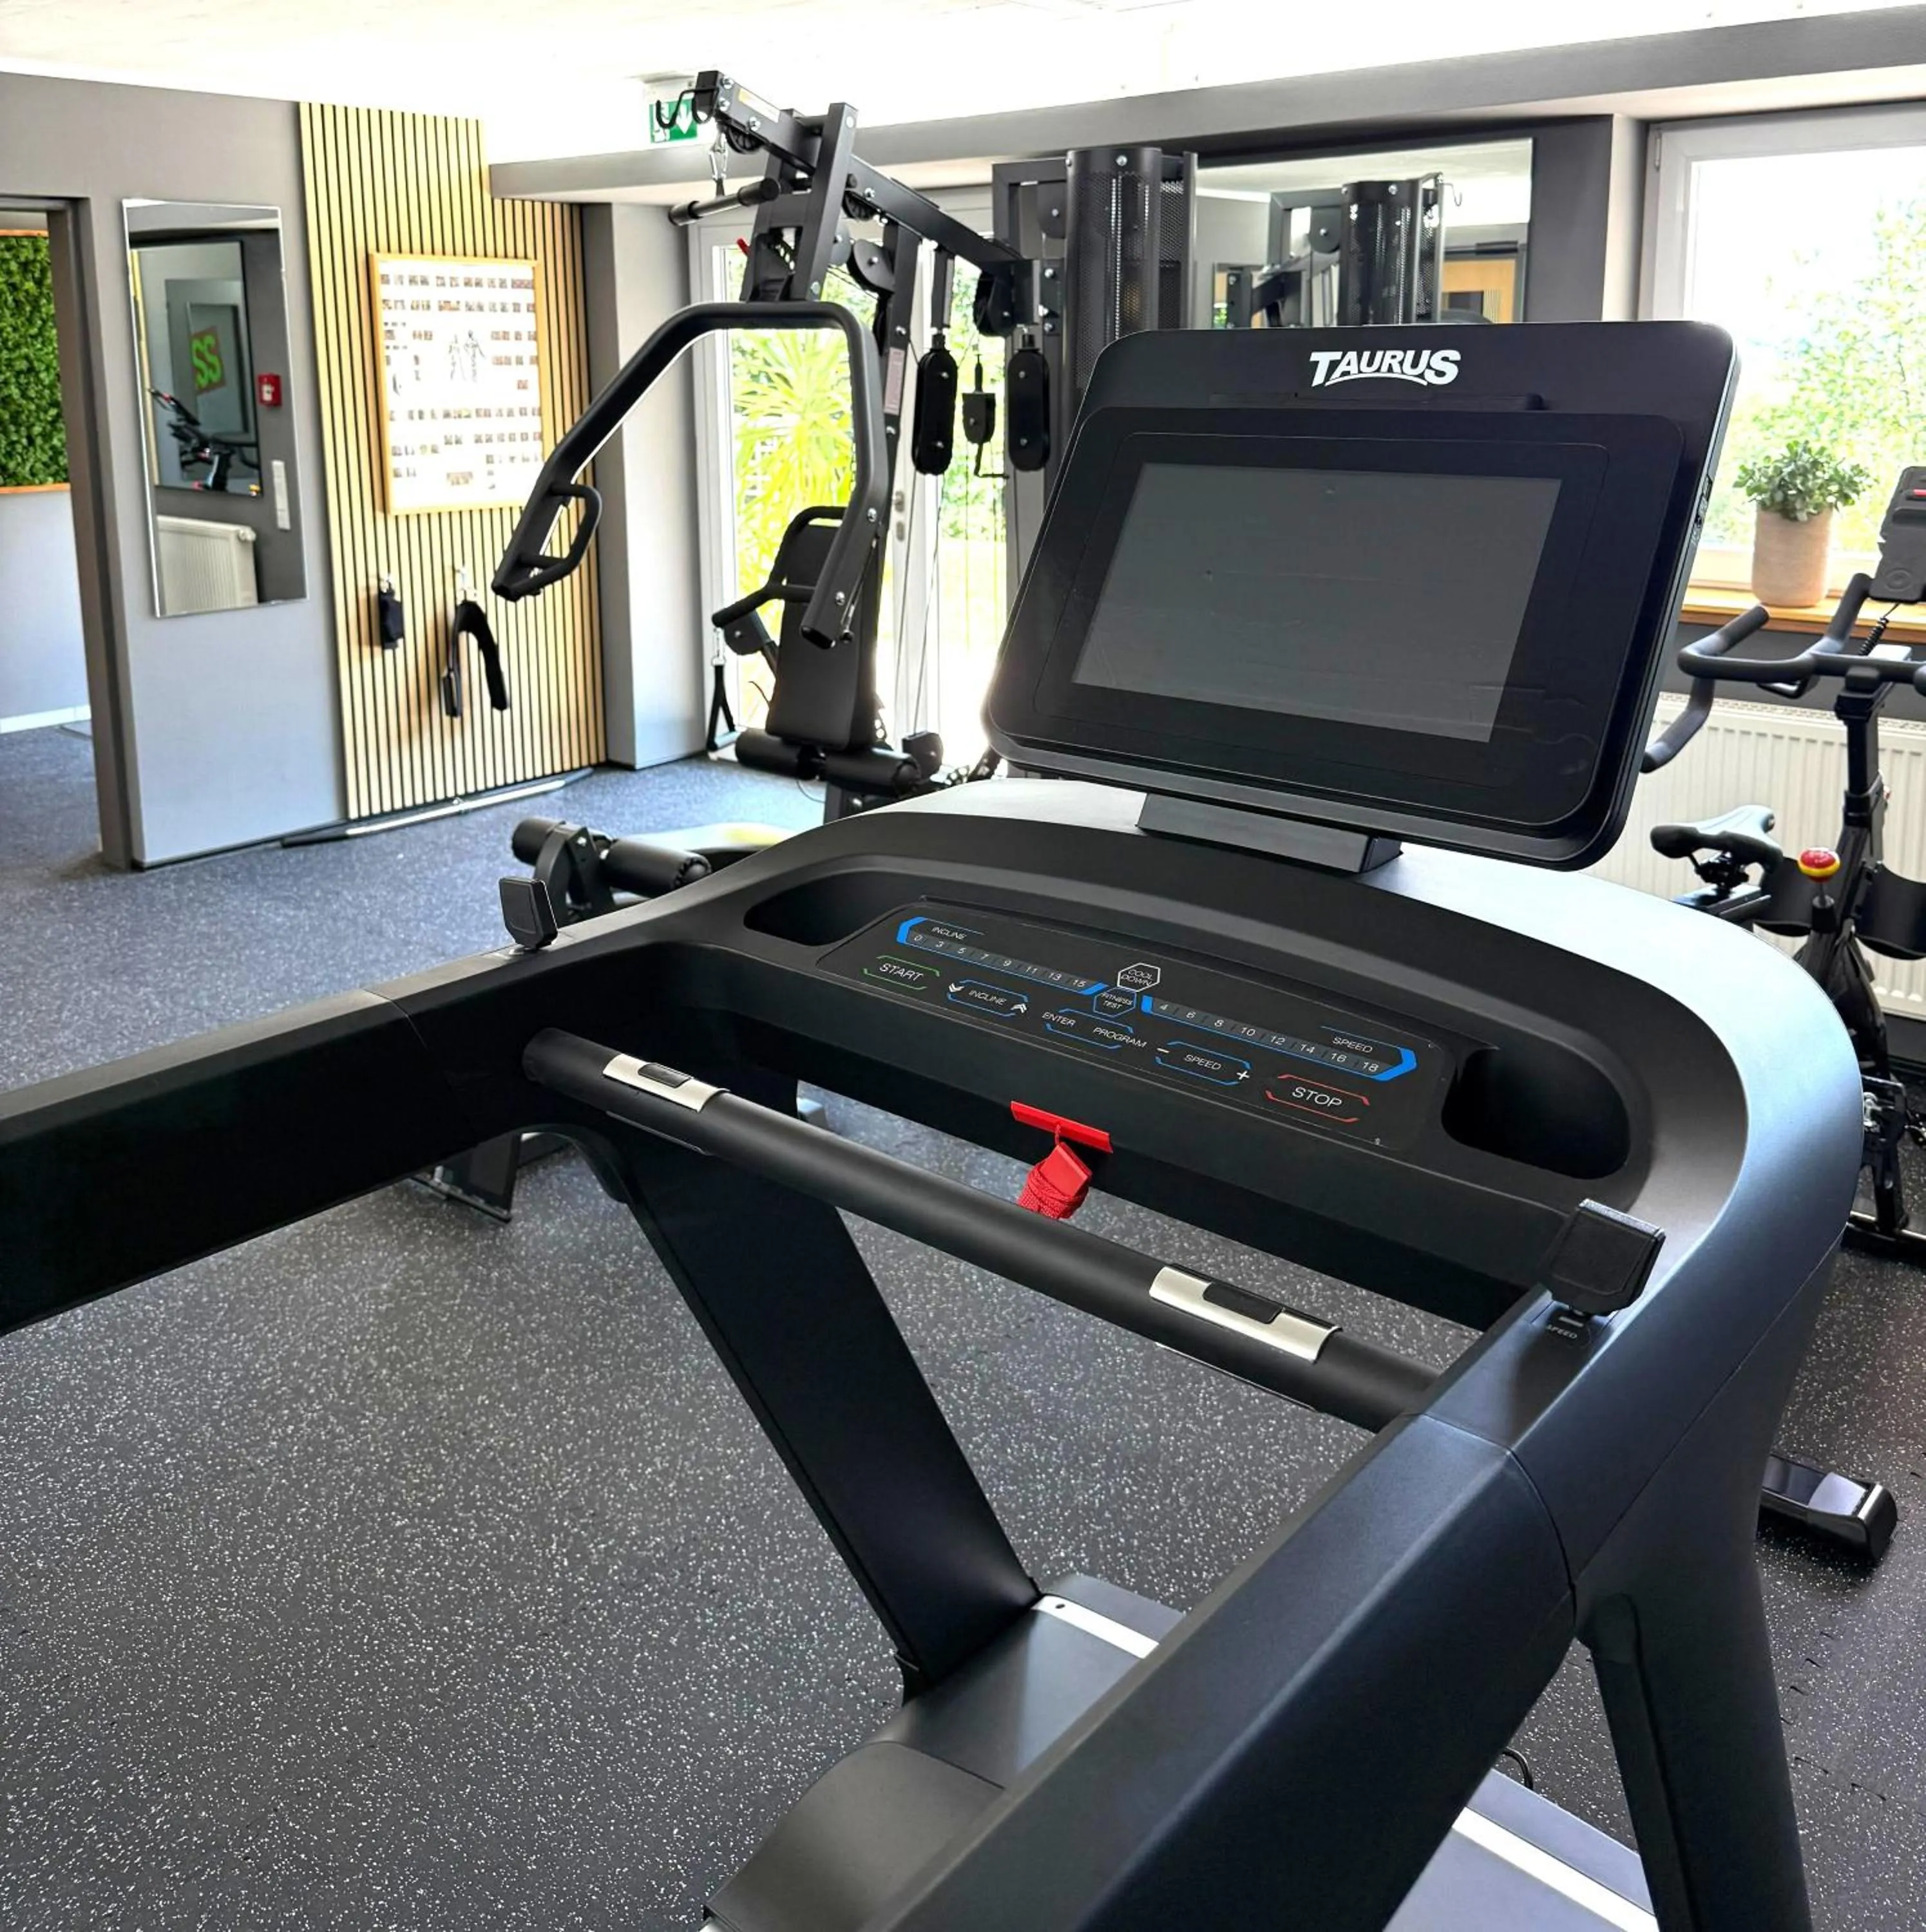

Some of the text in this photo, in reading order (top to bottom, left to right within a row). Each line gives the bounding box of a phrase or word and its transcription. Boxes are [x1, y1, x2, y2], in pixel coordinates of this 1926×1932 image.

[1310, 350, 1461, 386] TAURUS
[931, 927, 967, 940] INCLINE
[879, 963, 924, 981] START
[1048, 972, 1062, 981] 13
[1073, 979, 1087, 987] 15
[1121, 974, 1152, 986] DOWN
[1128, 969, 1152, 980] COOL
[968, 989, 1007, 1006] INCLINE
[1104, 1001, 1123, 1009] TEST
[1042, 1012, 1075, 1027] ENTER
[1093, 1027, 1147, 1048] PROGRAM
[1333, 1036, 1373, 1053] SPEED
[1241, 1027, 1256, 1036] 10
[1270, 1036, 1286, 1045] 12
[1299, 1045, 1315, 1054] 14
[1330, 1053, 1347, 1062] 16
[1360, 1061, 1379, 1072] 18
[1183, 1054, 1222, 1071] SPEED
[1292, 1086, 1342, 1108] STOP
